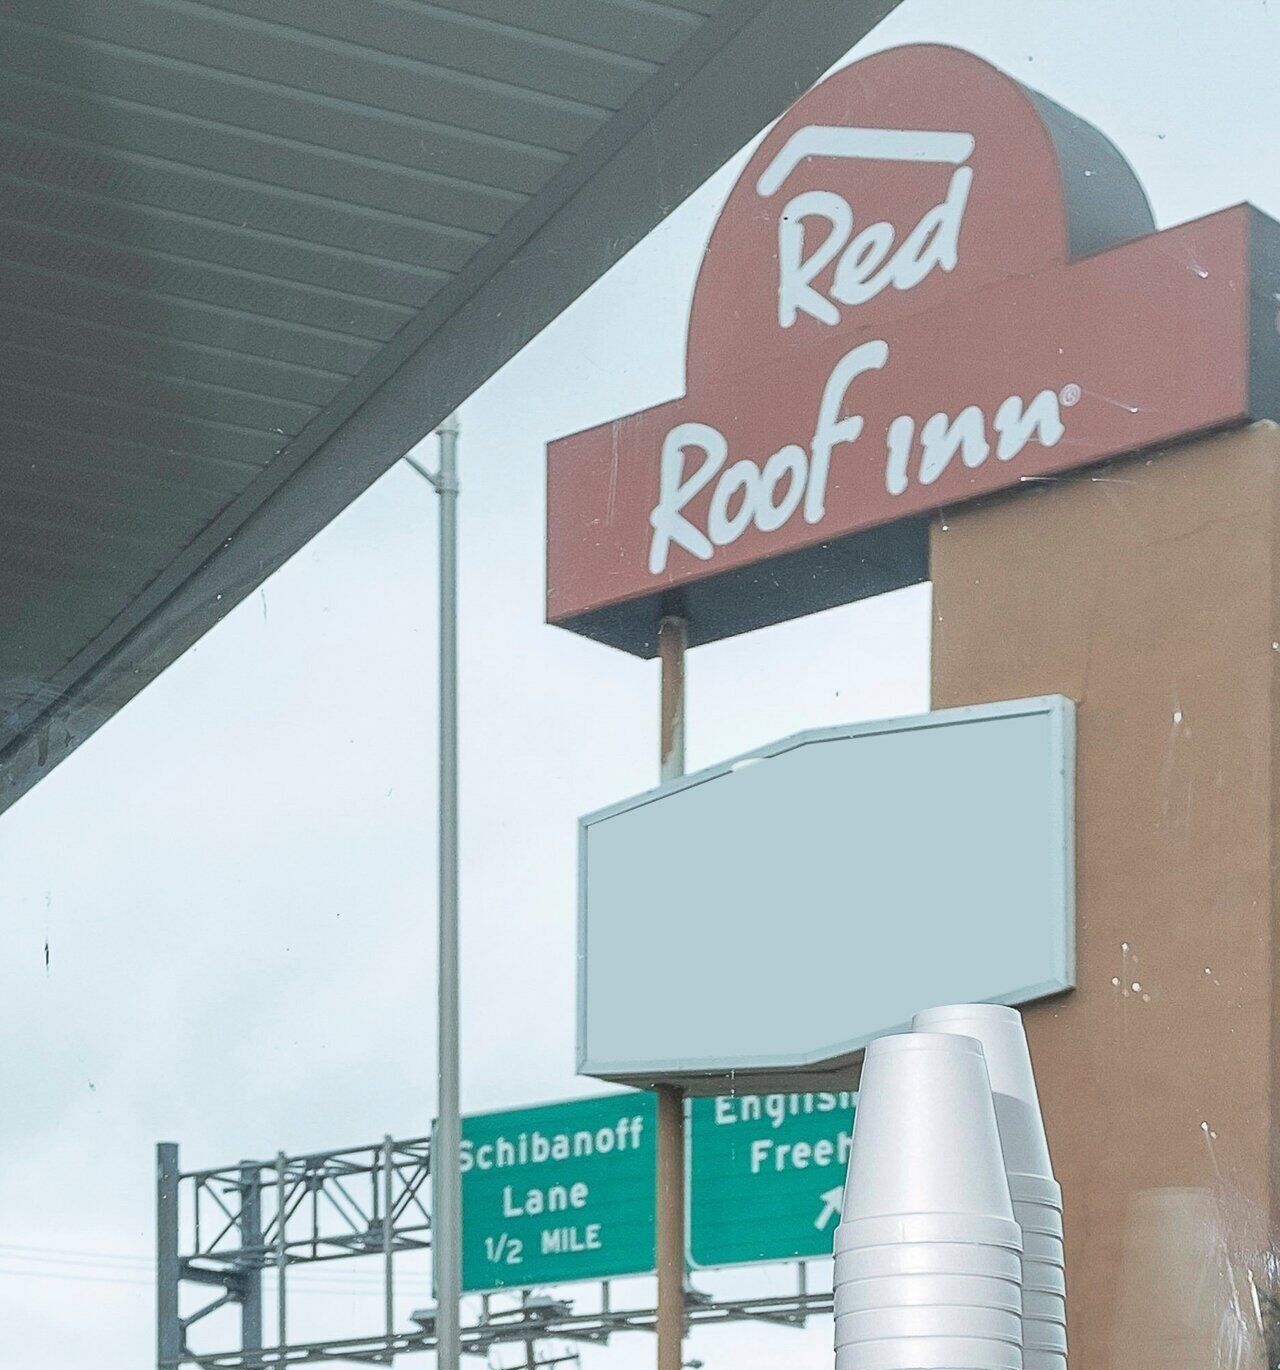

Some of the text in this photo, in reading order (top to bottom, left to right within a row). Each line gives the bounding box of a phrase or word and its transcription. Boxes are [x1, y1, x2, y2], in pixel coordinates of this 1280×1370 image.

[778, 166, 973, 328] Red
[649, 340, 889, 575] Roof
[459, 1115, 644, 1174] Schibanoff
[502, 1182, 589, 1218] Lane
[485, 1223, 602, 1265] 1/2 MILE
